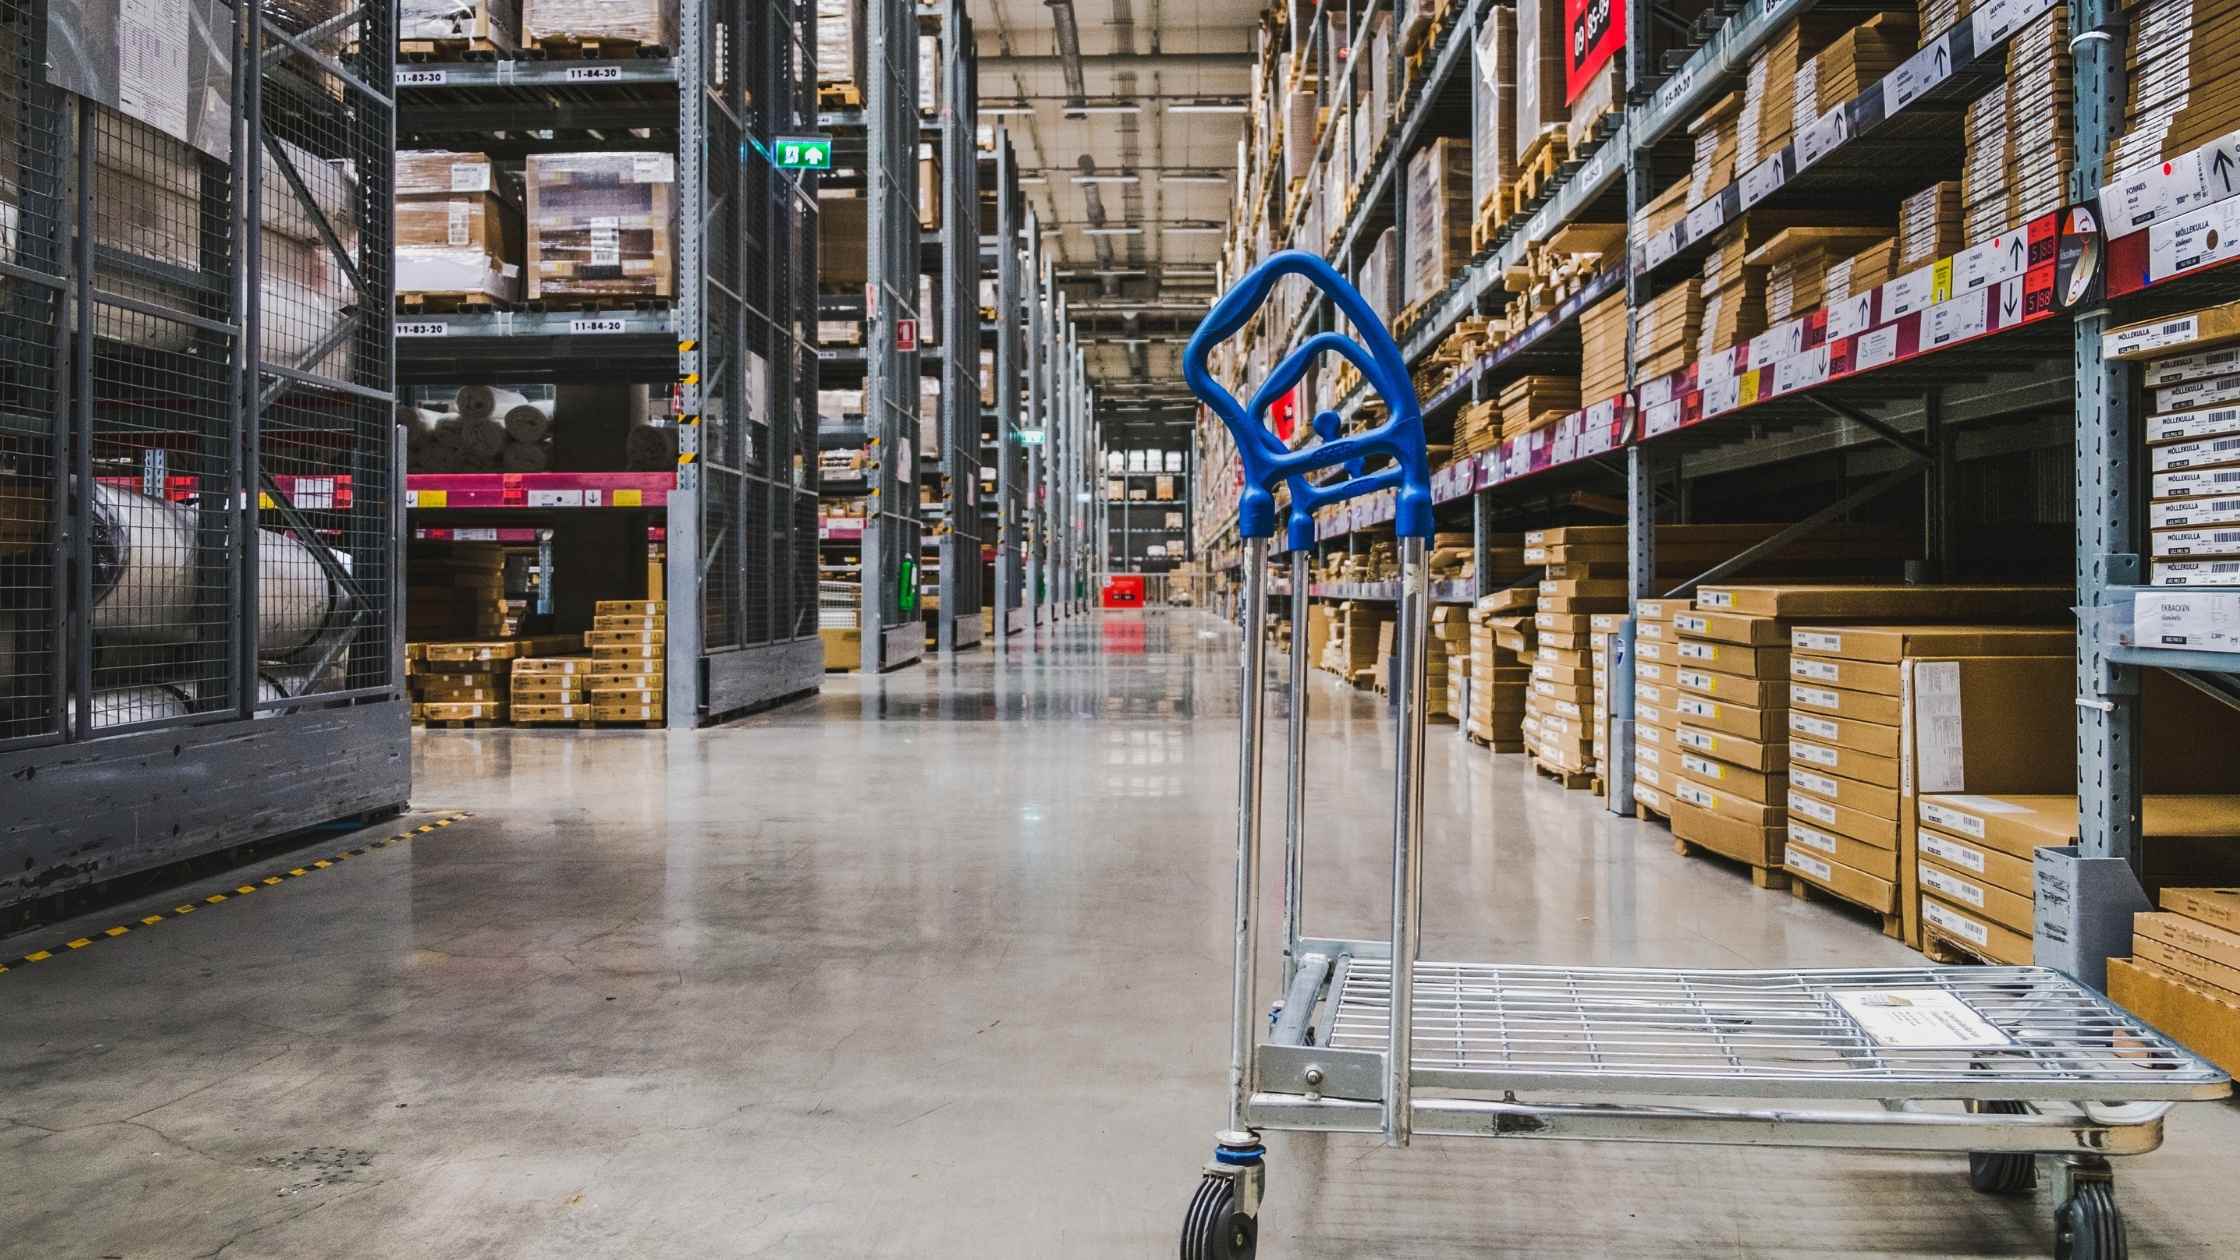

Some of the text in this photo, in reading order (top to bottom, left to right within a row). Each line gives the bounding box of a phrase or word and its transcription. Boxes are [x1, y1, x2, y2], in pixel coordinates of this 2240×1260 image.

[396, 73, 442, 83] 11-83-30
[570, 69, 617, 79] 11-84-30
[2175, 220, 2209, 238] MÖLLEKULLA
[397, 325, 443, 335] 11-83-20
[574, 321, 621, 331] 11-84-20
[2118, 328, 2150, 340] MÖLLEKULLA
[2162, 415, 2195, 425] MÖLLEKULLA
[2168, 444, 2200, 454] MÖLLEKULLA
[2168, 473, 2200, 482] MÖLLEKULLA
